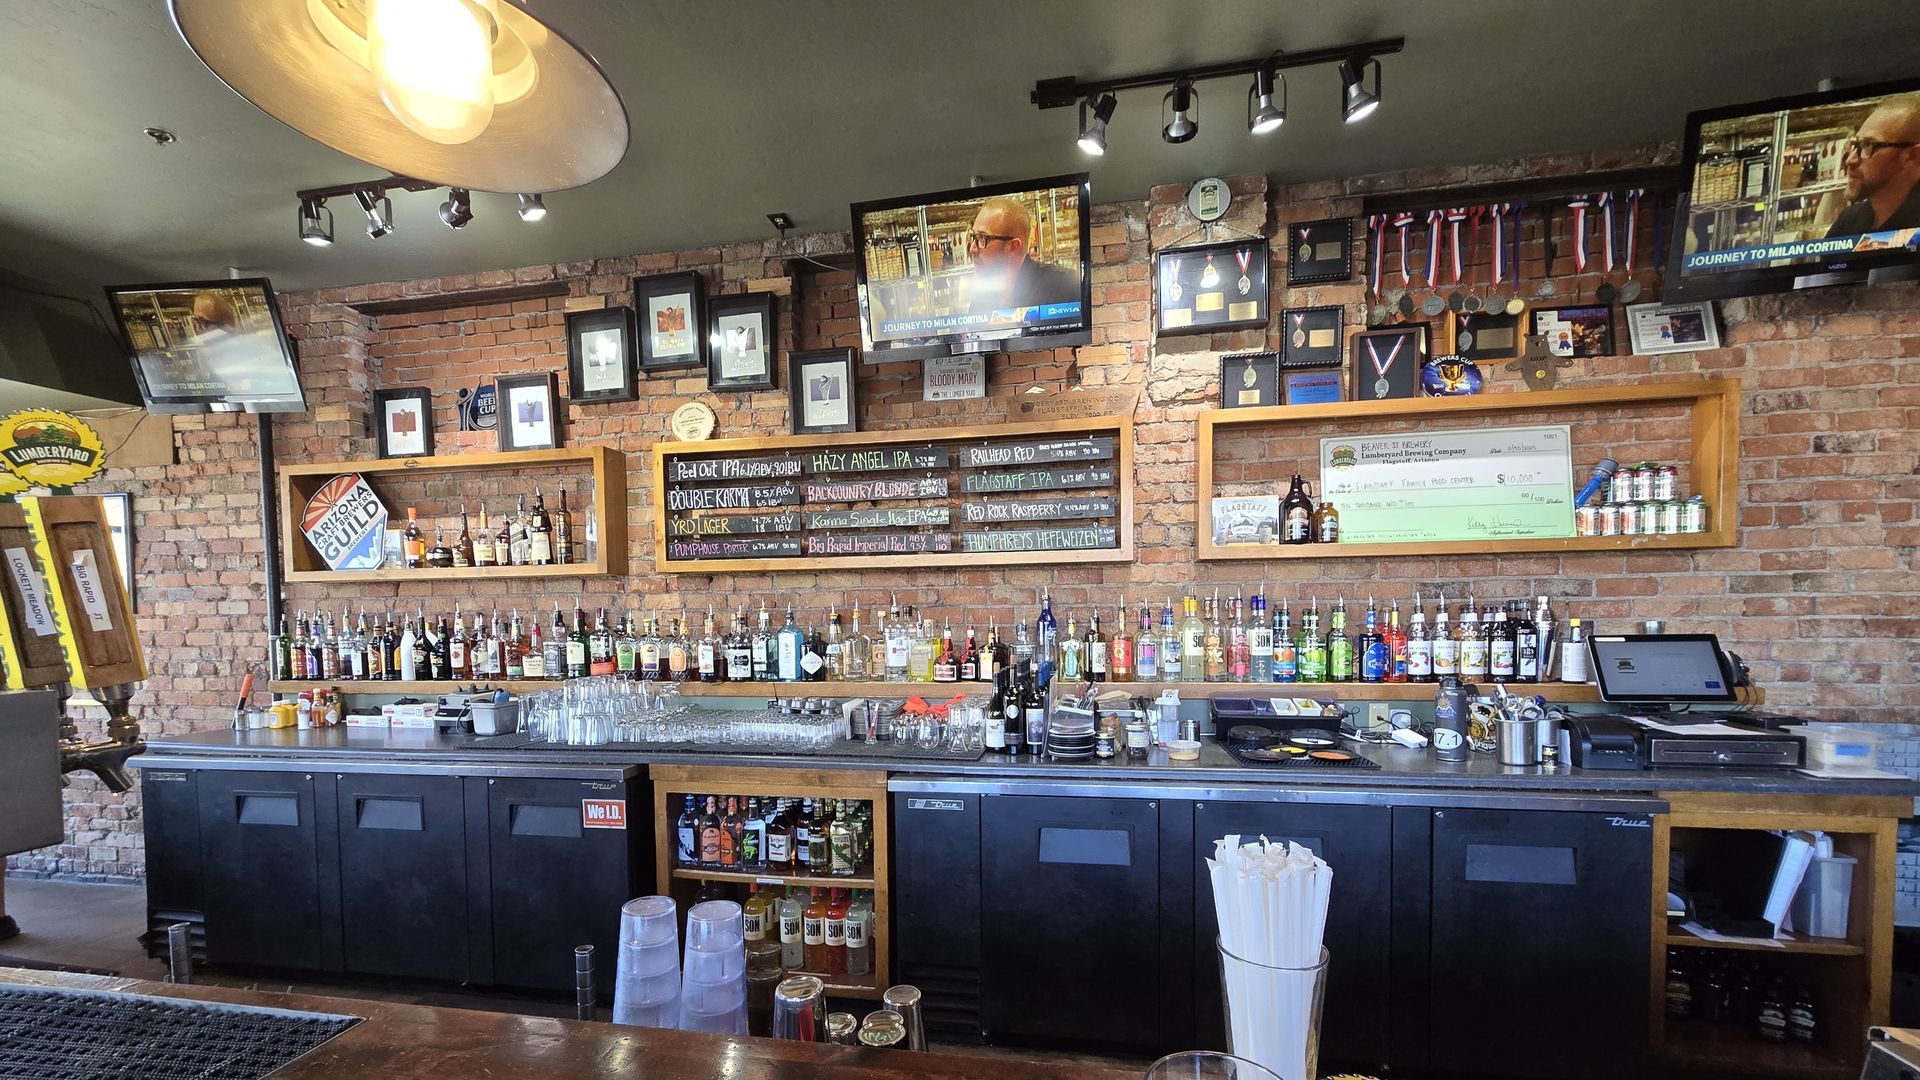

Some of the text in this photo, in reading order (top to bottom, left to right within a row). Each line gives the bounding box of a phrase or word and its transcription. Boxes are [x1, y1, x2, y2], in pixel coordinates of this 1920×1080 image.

[1687, 239, 1854, 268] JOURNEY TO MILAN CORTINA
[882, 314, 988, 333] JOURNEY TO MILAN CORTINA
[929, 371, 978, 387] BLOODY MARY
[10, 446, 90, 463] LUMBERYARD
[1361, 441, 1389, 452] BEAVER
[1402, 440, 1433, 449] BREWERY
[1361, 448, 1467, 459] Lumberyard Brewing Company
[812, 450, 912, 472] HAZY ANGEL IPA
[970, 447, 1011, 466] RAILHEAD
[1014, 447, 1035, 461] RED
[678, 459, 740, 481] Peel Out IPA
[1496, 473, 1504, 484] $
[966, 472, 1026, 491] FLAGSTAFF
[1029, 471, 1055, 488] IPA
[670, 490, 714, 510] DOUBLE
[715, 487, 750, 508] KARMA
[775, 487, 795, 497] ABV
[808, 482, 917, 501] BACKCOUNTRY BLONDE
[312, 485, 369, 545] ARIZONA
[317, 491, 373, 550] CRAFT BREWERS
[812, 514, 848, 529] Karma
[850, 512, 887, 527] Single
[906, 509, 927, 524] IPA
[966, 504, 985, 521] RED
[987, 503, 1010, 519] ROCK
[1011, 502, 1062, 518] RASPBERRY
[324, 499, 379, 561] GUILD
[671, 518, 696, 535] YRD
[697, 517, 731, 534] LAGER
[774, 515, 794, 524] ABV
[809, 535, 907, 554] Big Rapid Imperial Red
[968, 528, 1100, 551] HUMPHREYS HEFEWEIZEN
[674, 542, 721, 557] PUMPHOUSE
[723, 543, 749, 554] PORTER
[75, 565, 87, 580] BIG
[12, 557, 46, 627] LOCKETT MEADOW
[80, 579, 96, 604] RAPID
[1255, 634, 1271, 648] SON
[587, 804, 622, 820] We I.D.
[744, 919, 760, 932] SON
[784, 921, 800, 935] SON
[806, 923, 821, 937] SON
[828, 924, 844, 938] SON
[846, 925, 862, 940] SON
